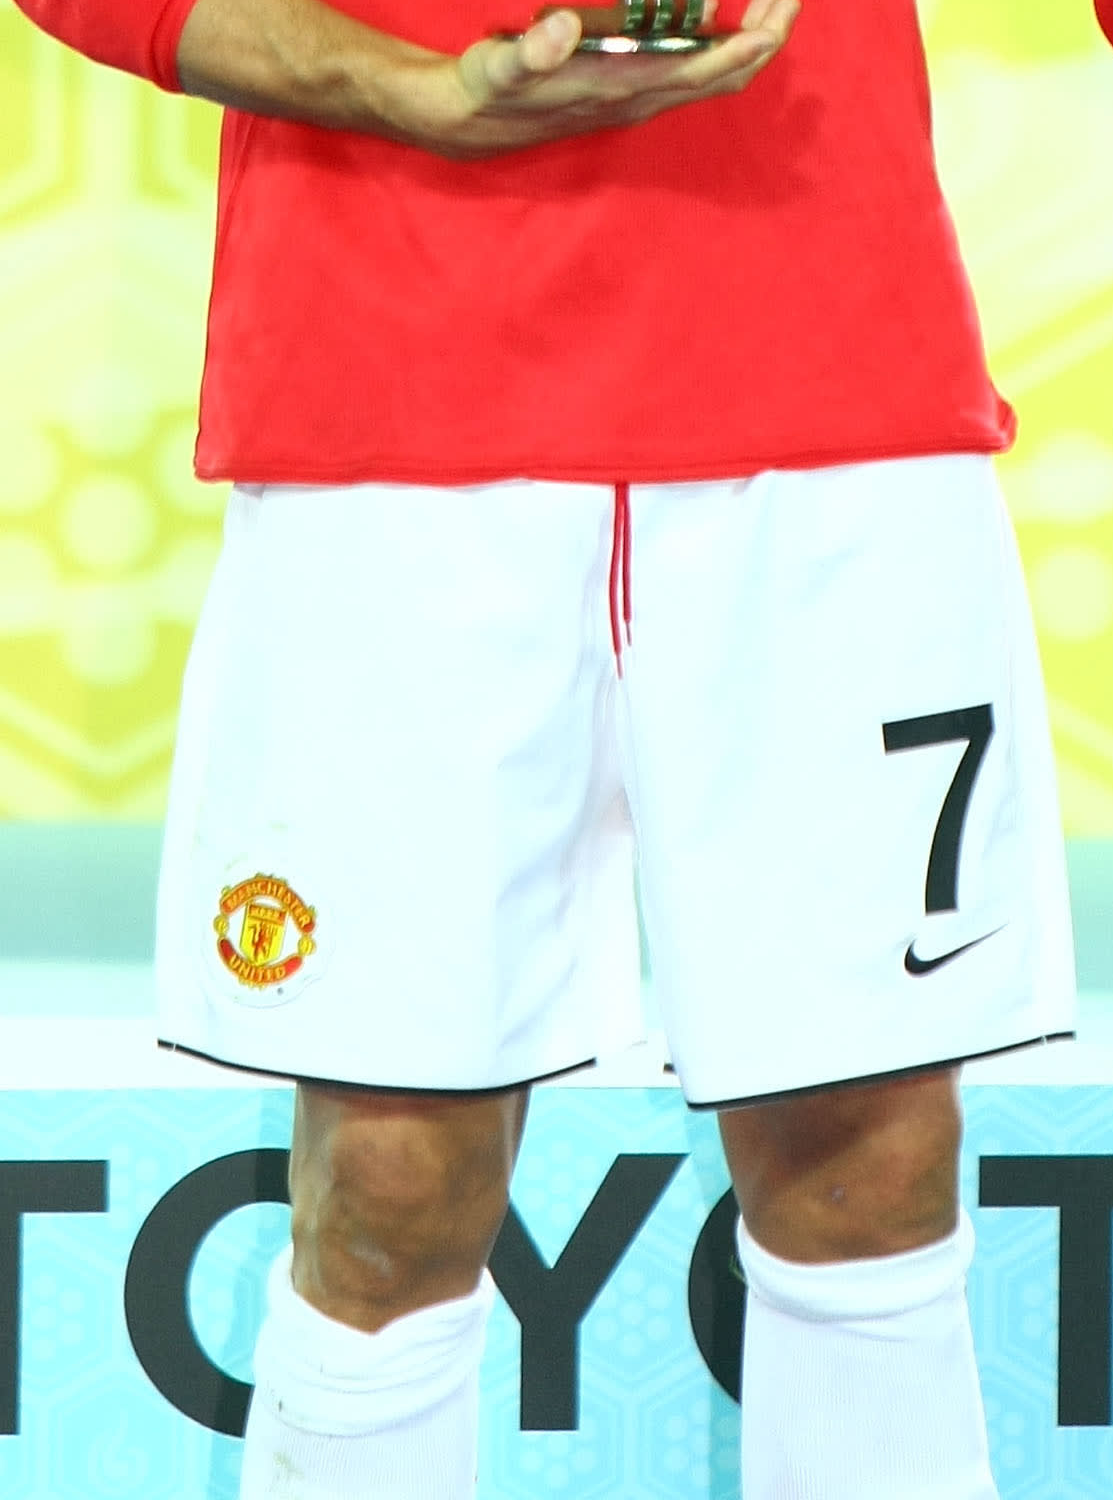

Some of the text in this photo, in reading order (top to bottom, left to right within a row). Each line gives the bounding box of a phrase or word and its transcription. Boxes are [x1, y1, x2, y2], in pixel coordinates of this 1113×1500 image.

[882, 701, 996, 916] 7
[228, 879, 312, 929] MANCHESTER
[229, 954, 287, 980] UNITED
